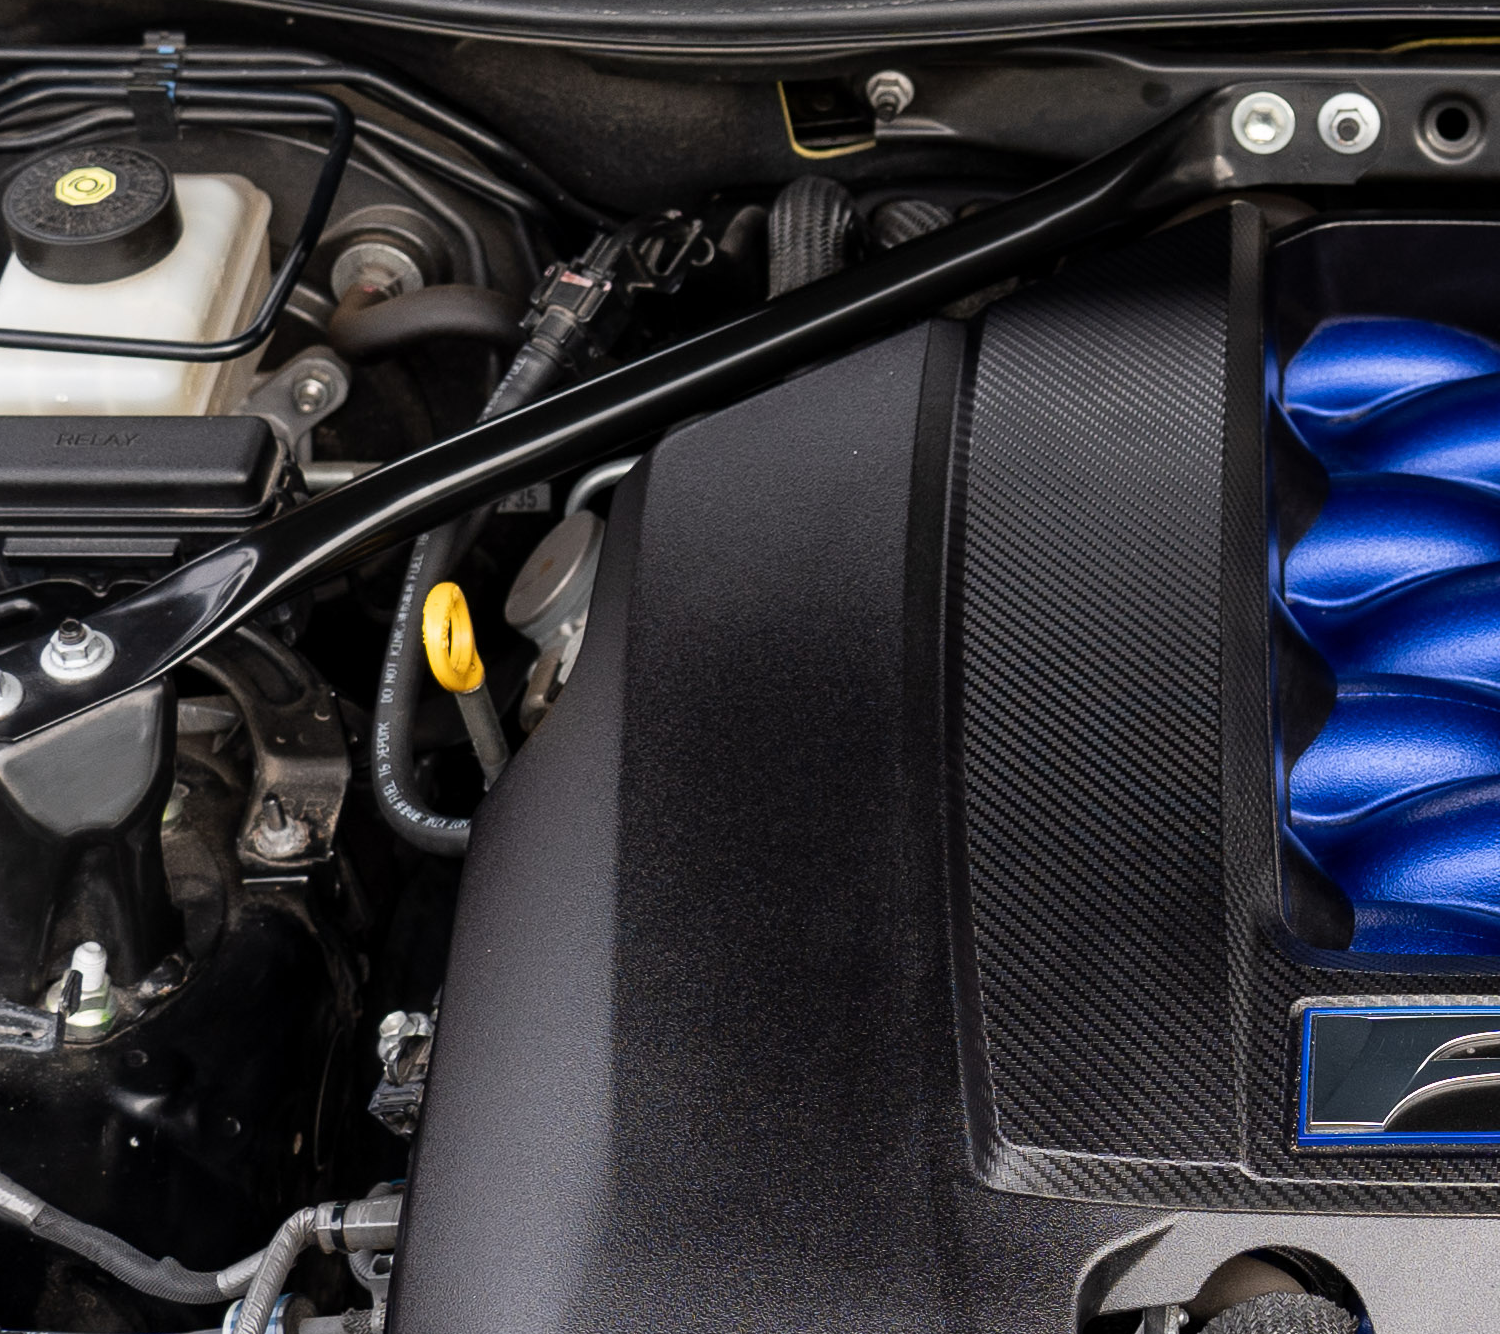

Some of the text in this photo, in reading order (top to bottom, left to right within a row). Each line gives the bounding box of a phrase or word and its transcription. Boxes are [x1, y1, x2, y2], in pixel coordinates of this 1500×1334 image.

[55, 432, 141, 447] RELAY
[382, 660, 399, 685] NOT
[379, 686, 395, 705] DO
